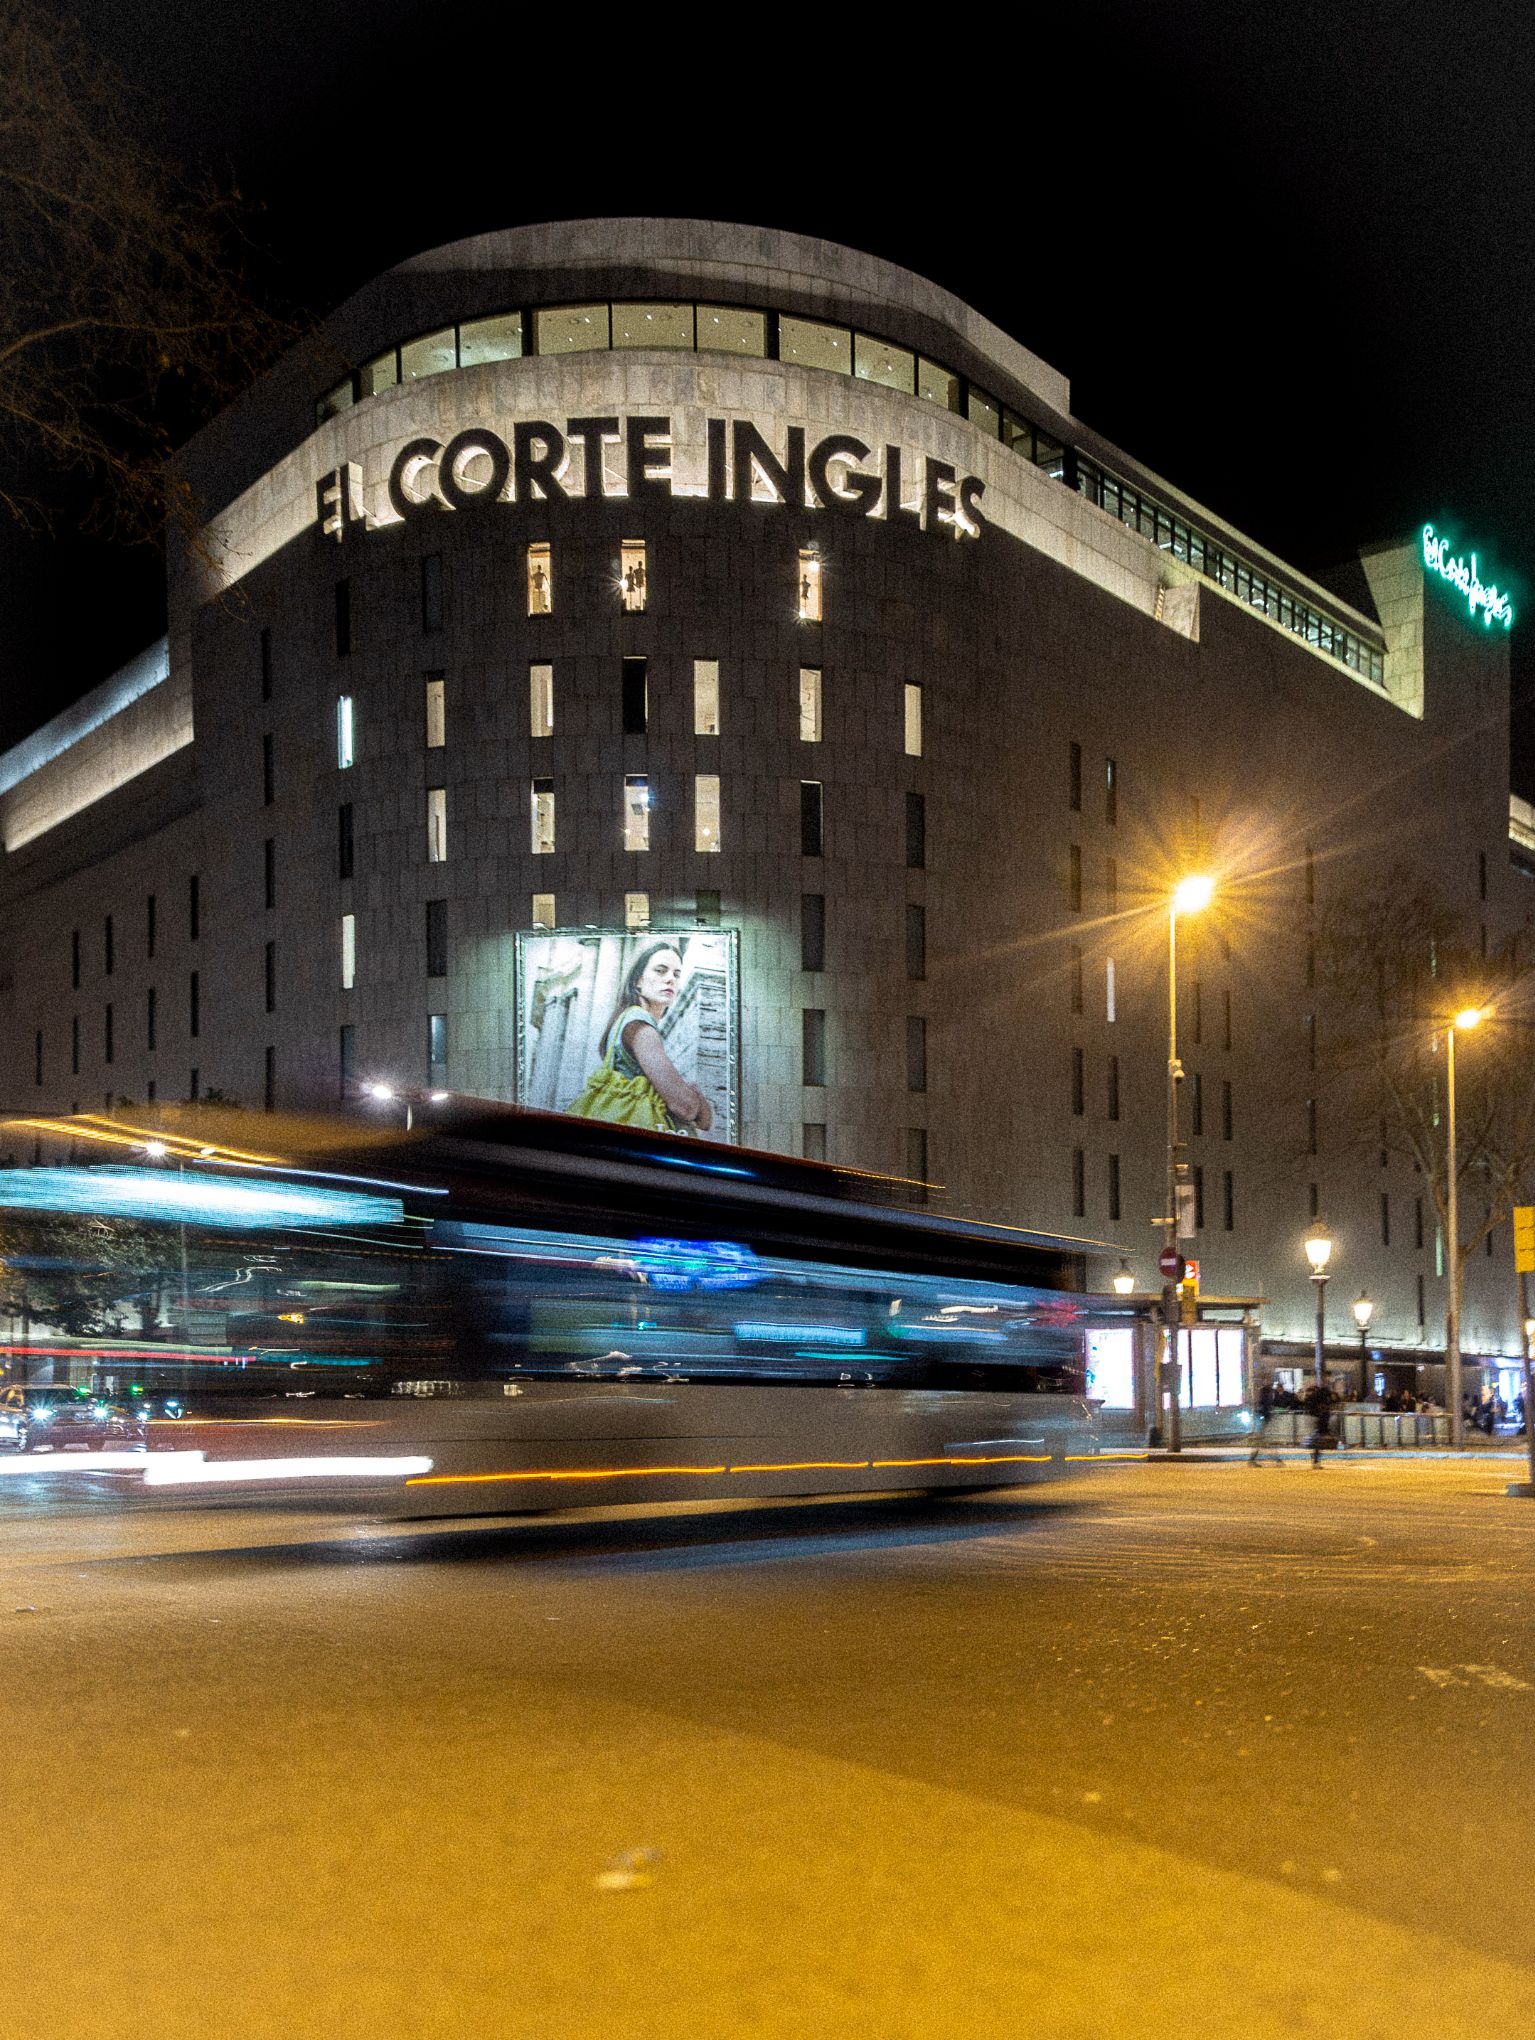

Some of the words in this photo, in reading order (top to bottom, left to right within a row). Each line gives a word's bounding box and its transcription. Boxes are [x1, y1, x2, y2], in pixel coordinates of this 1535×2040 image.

[316, 462, 368, 542] EL
[388, 415, 672, 518] CORTE
[706, 418, 986, 542] INGLES
